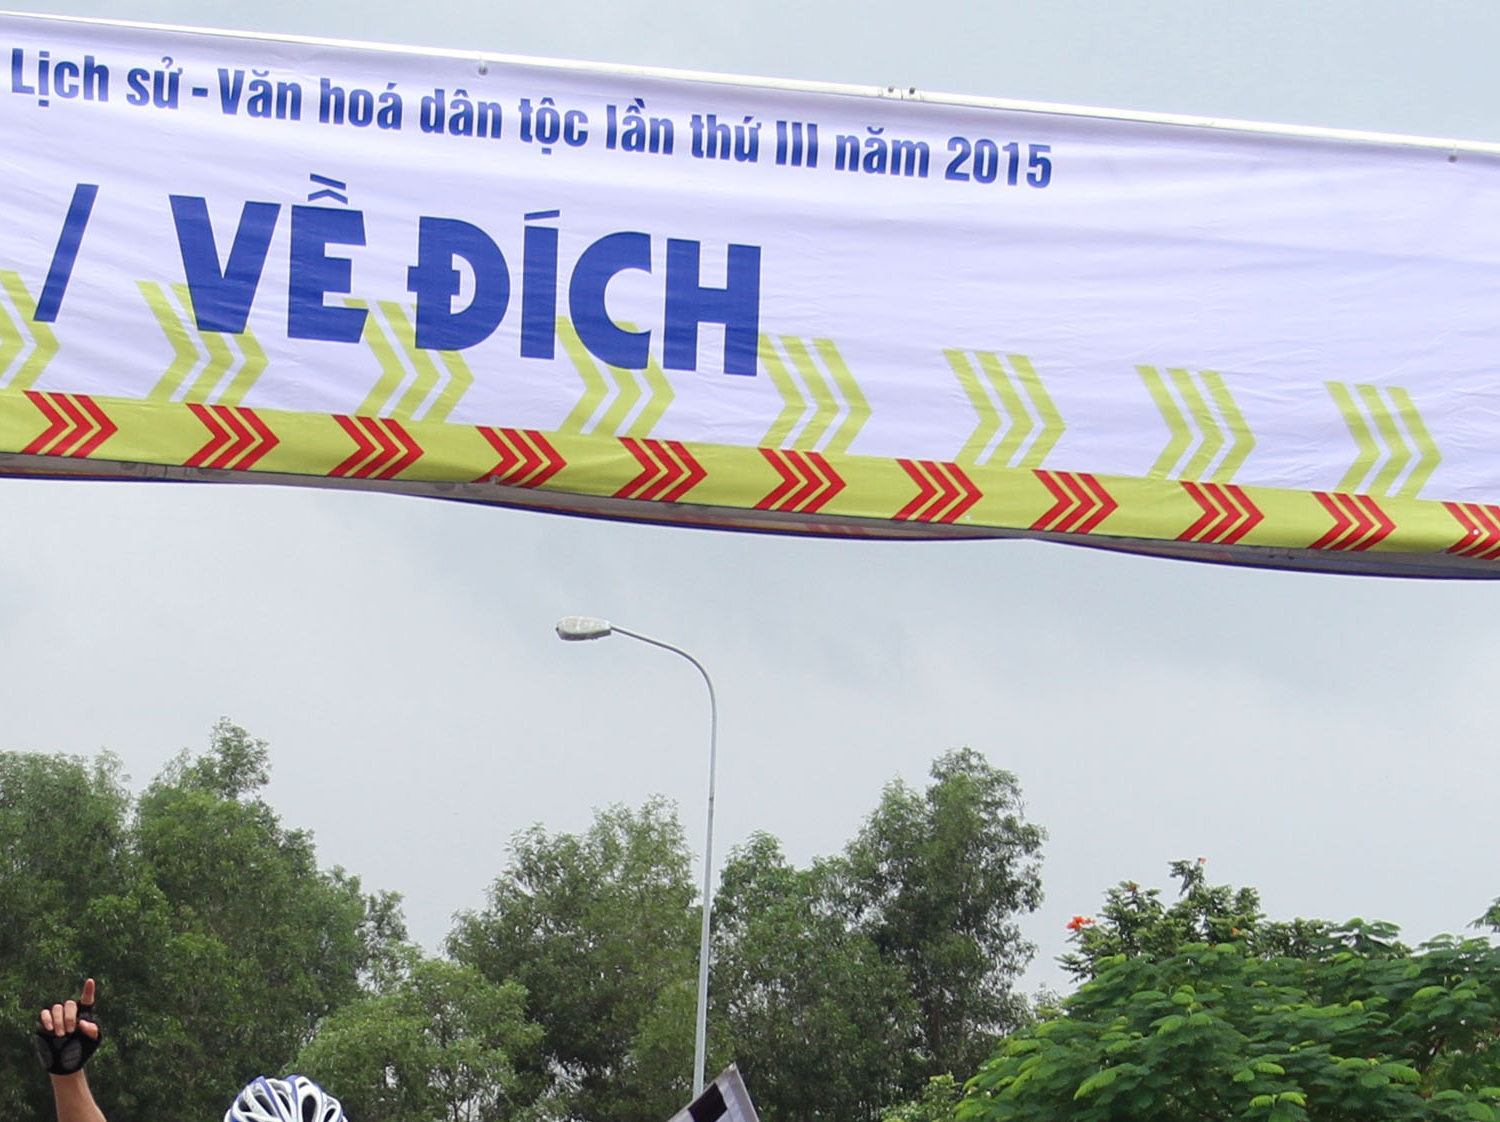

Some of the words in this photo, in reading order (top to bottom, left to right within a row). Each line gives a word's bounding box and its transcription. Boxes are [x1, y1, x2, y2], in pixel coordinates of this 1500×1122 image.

[12, 48, 109, 107] Lịch
[127, 56, 182, 108] sử
[219, 68, 301, 120] Văn
[319, 78, 402, 130] hoá
[420, 88, 502, 138] dân
[519, 97, 588, 155] tộc
[606, 98, 673, 155] lần
[691, 114, 761, 162] thứ
[776, 120, 818, 168] III
[836, 127, 929, 177] năm
[945, 137, 1051, 188] 2015
[33, 183, 99, 323] /
[169, 173, 367, 344] VỀ
[407, 209, 762, 376] ĐÍCH
